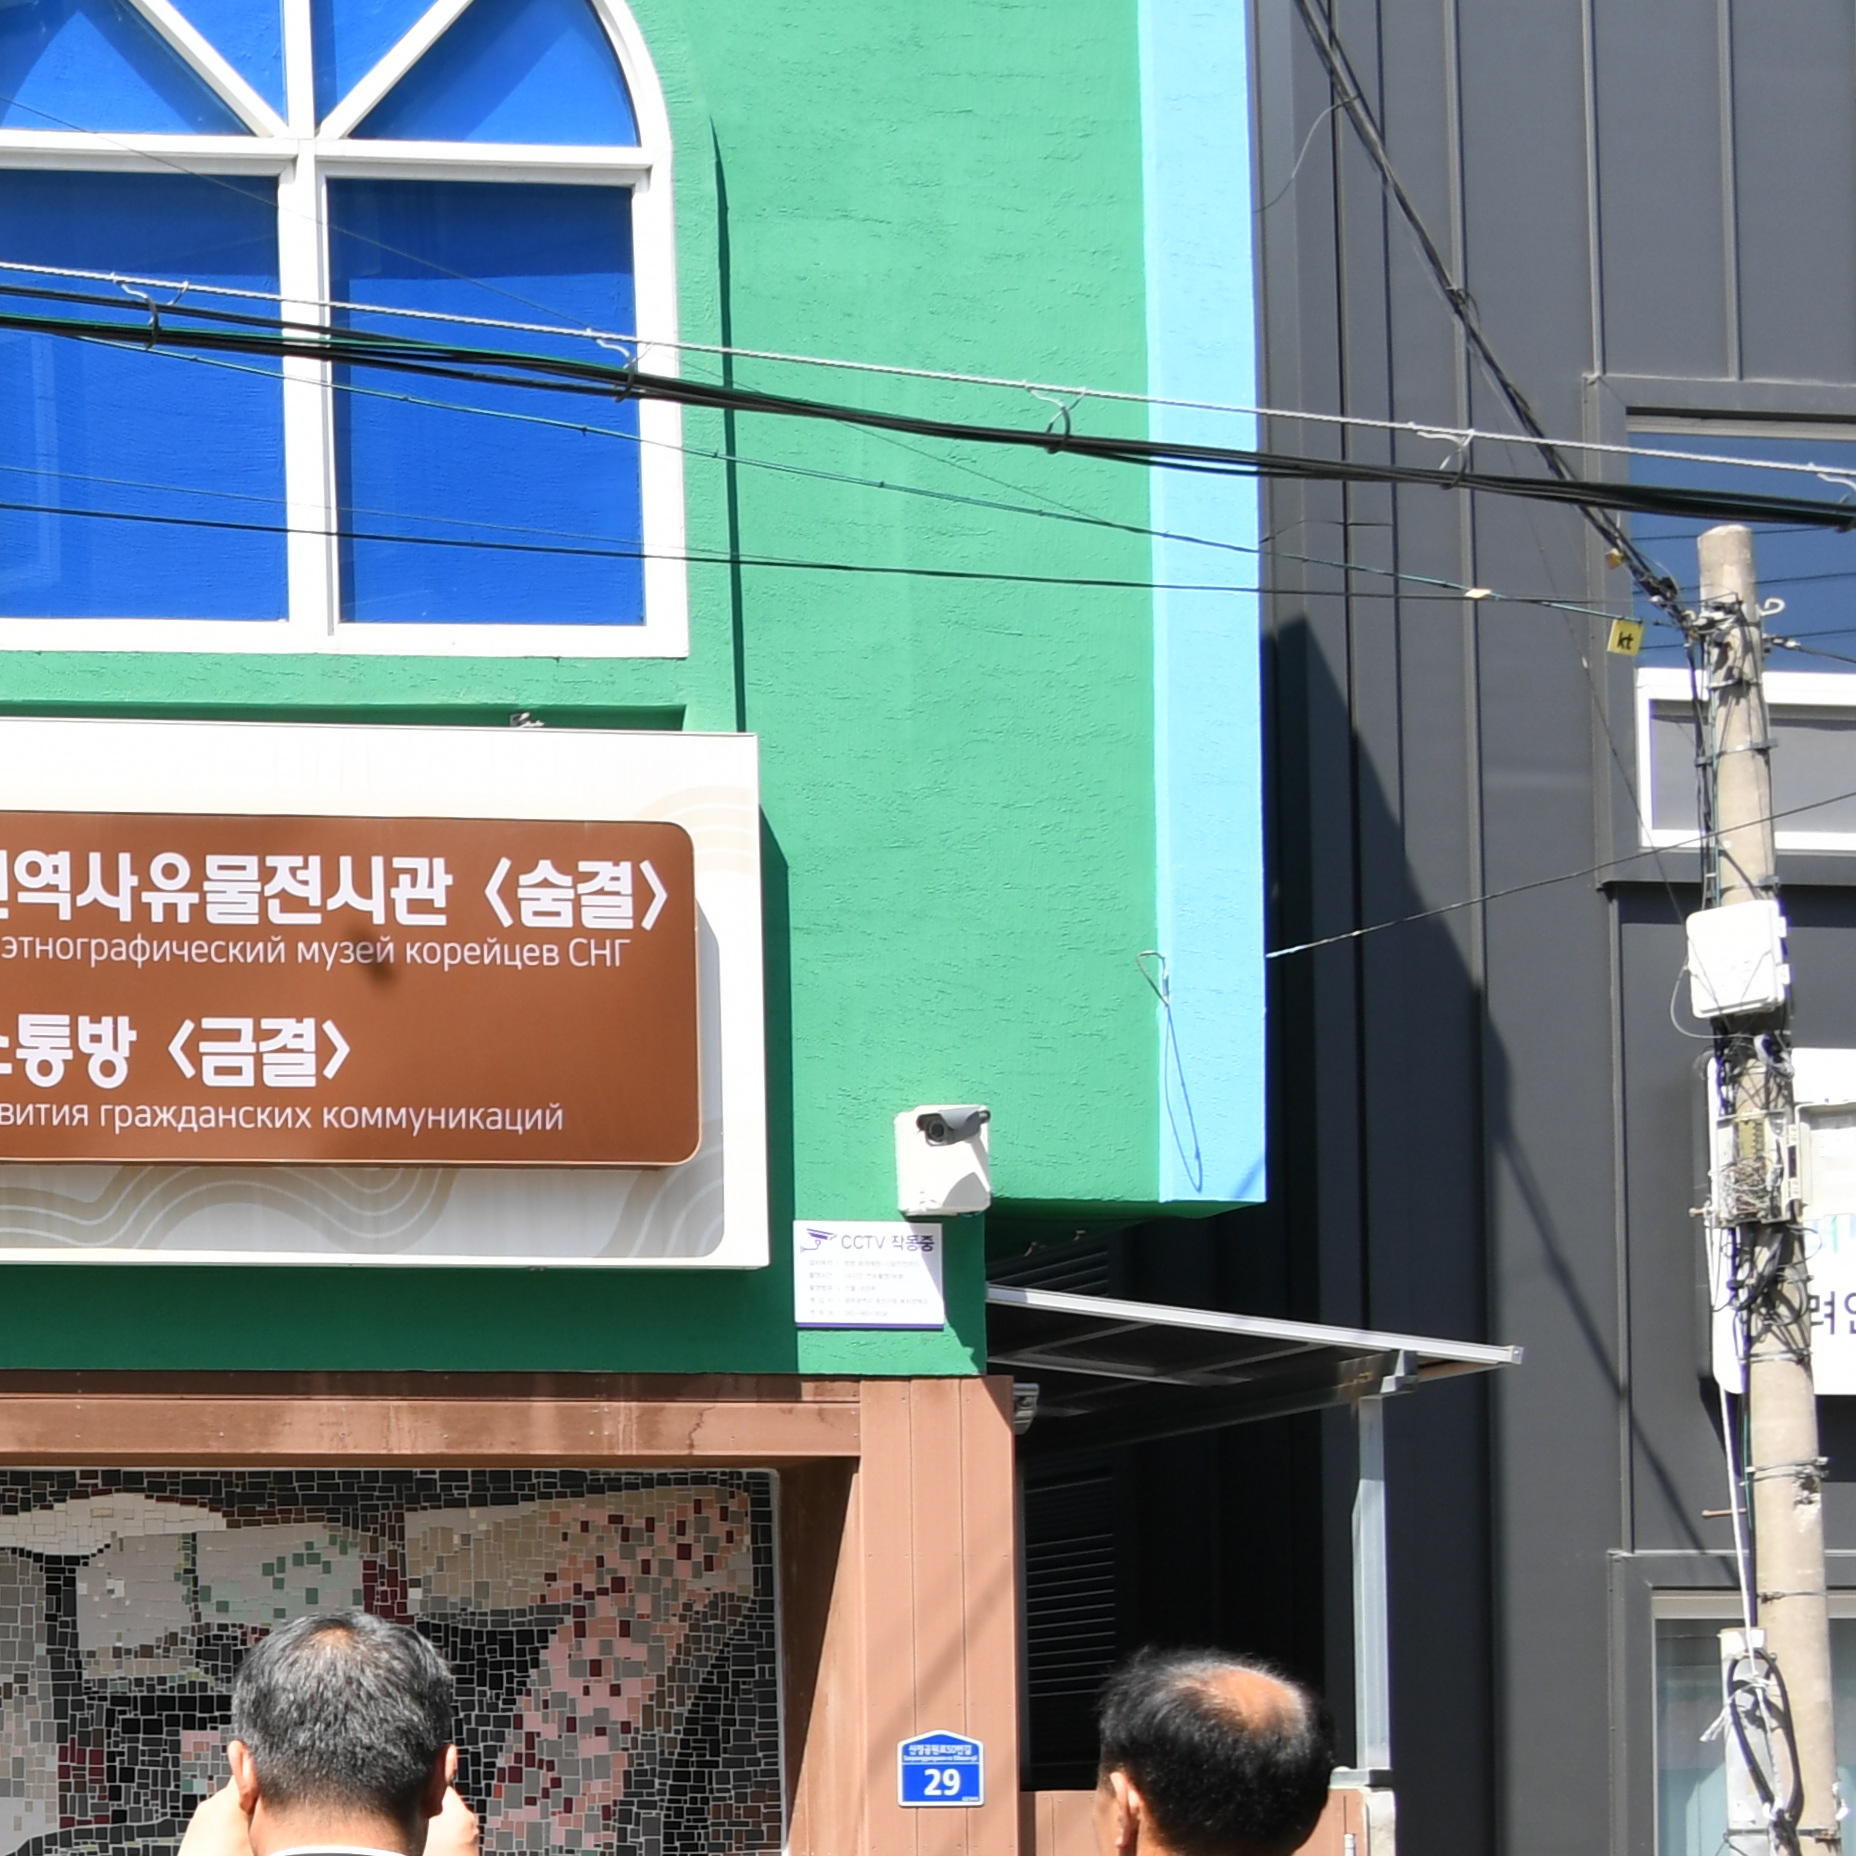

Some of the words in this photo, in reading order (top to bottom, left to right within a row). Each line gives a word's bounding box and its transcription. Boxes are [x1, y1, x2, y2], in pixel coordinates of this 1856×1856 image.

[1616, 631, 1634, 651] kt
[297, 936, 394, 972] музей
[405, 938, 560, 973] корейцев
[568, 938, 631, 968] СНГ
[99, 1103, 313, 1135] гражданских
[322, 1102, 564, 1137] коммуникаций
[840, 1234, 886, 1250] CCTV
[891, 1234, 935, 1252] 작동중
[923, 1767, 961, 1796] 29
